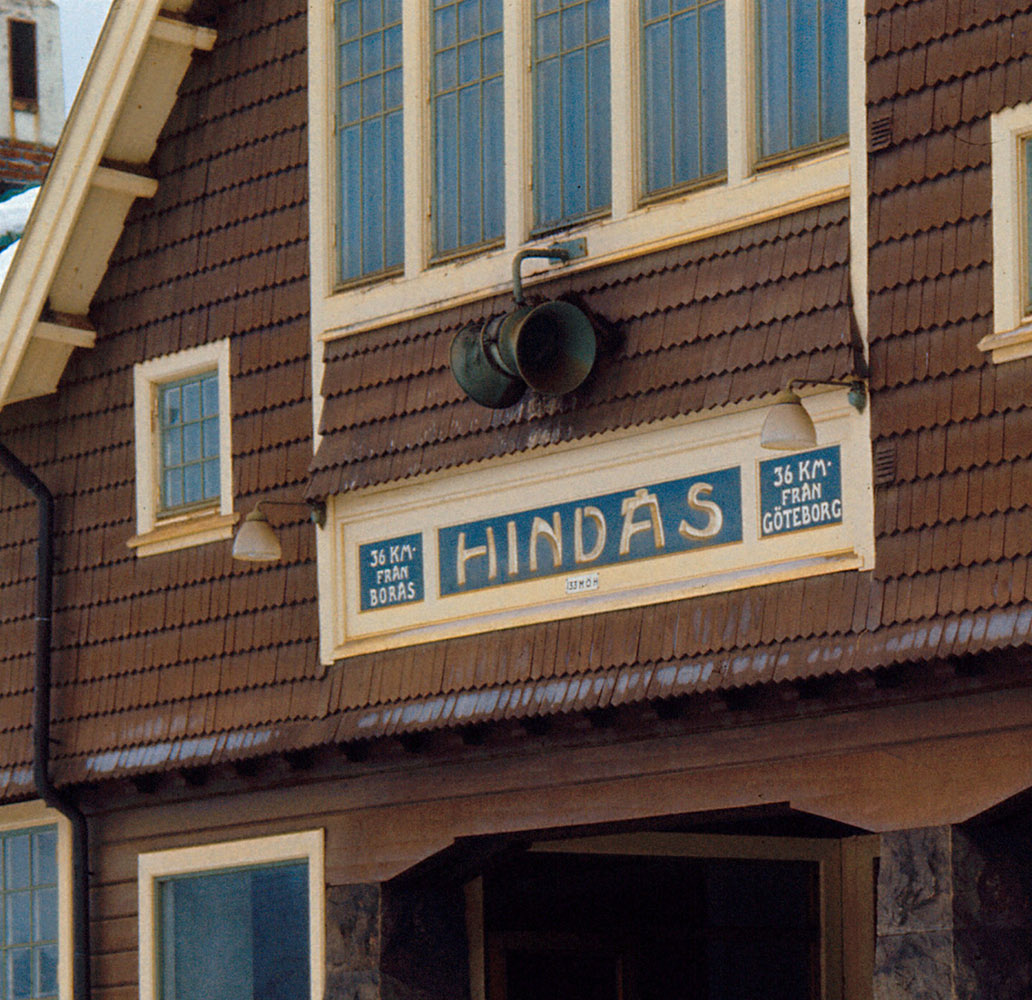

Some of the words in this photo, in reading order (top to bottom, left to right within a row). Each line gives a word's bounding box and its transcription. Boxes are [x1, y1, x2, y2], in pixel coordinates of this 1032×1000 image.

[773, 464, 793, 487] 36
[762, 499, 841, 534] GÖTEBORG
[456, 481, 723, 586] HINDÅS
[370, 549, 385, 567] 36
